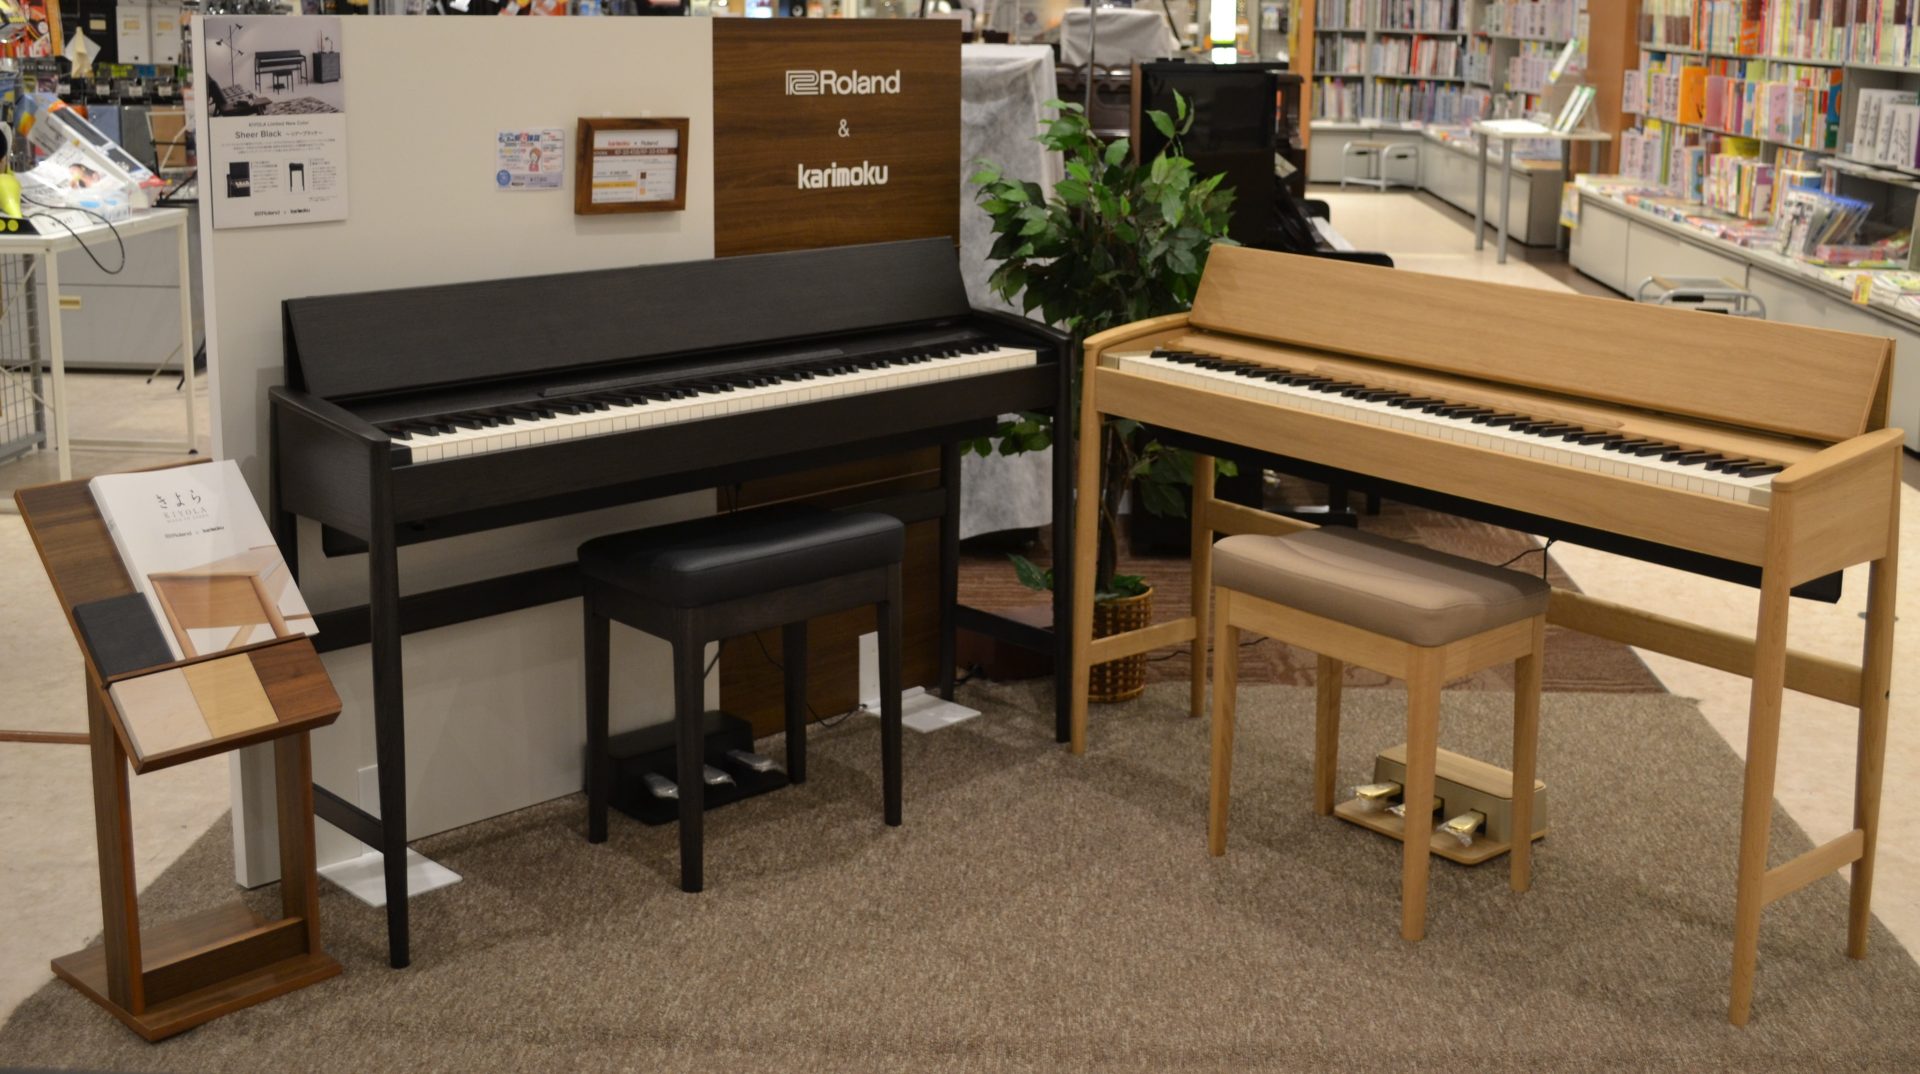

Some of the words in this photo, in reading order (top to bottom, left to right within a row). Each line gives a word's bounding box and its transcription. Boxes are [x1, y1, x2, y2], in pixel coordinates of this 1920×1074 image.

[820, 69, 900, 95] Roland
[235, 130, 258, 139] Sheer
[260, 129, 281, 138] Black
[838, 118, 850, 138] &
[798, 160, 888, 190] karimoku
[155, 489, 202, 509] きよら
